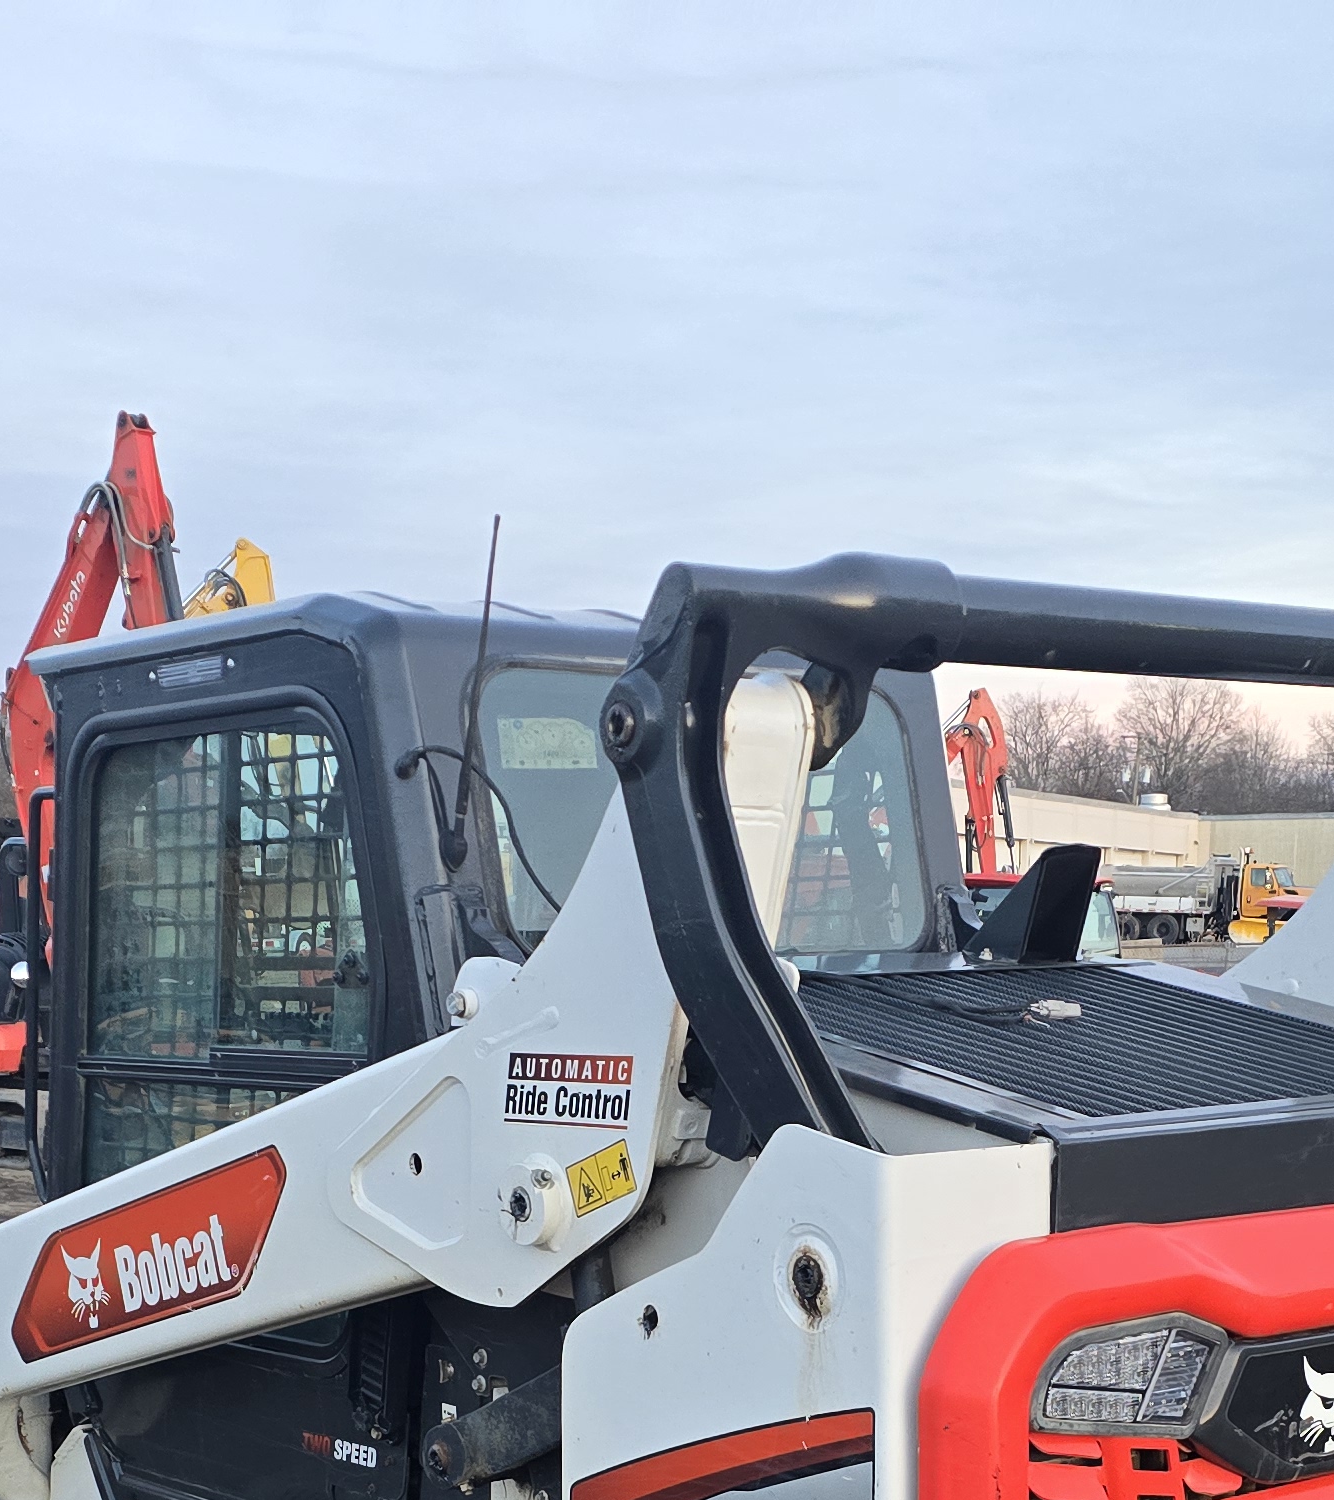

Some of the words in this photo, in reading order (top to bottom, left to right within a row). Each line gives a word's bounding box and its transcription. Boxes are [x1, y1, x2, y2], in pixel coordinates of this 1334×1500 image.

[53, 570, 86, 638] Kubota
[511, 1056, 629, 1082] AUTOMATIC
[504, 1083, 549, 1117] Ride
[554, 1086, 631, 1122] Control
[113, 1213, 231, 1313] Bobcat
[302, 1431, 332, 1455] TWO
[333, 1438, 378, 1469] SPEED
